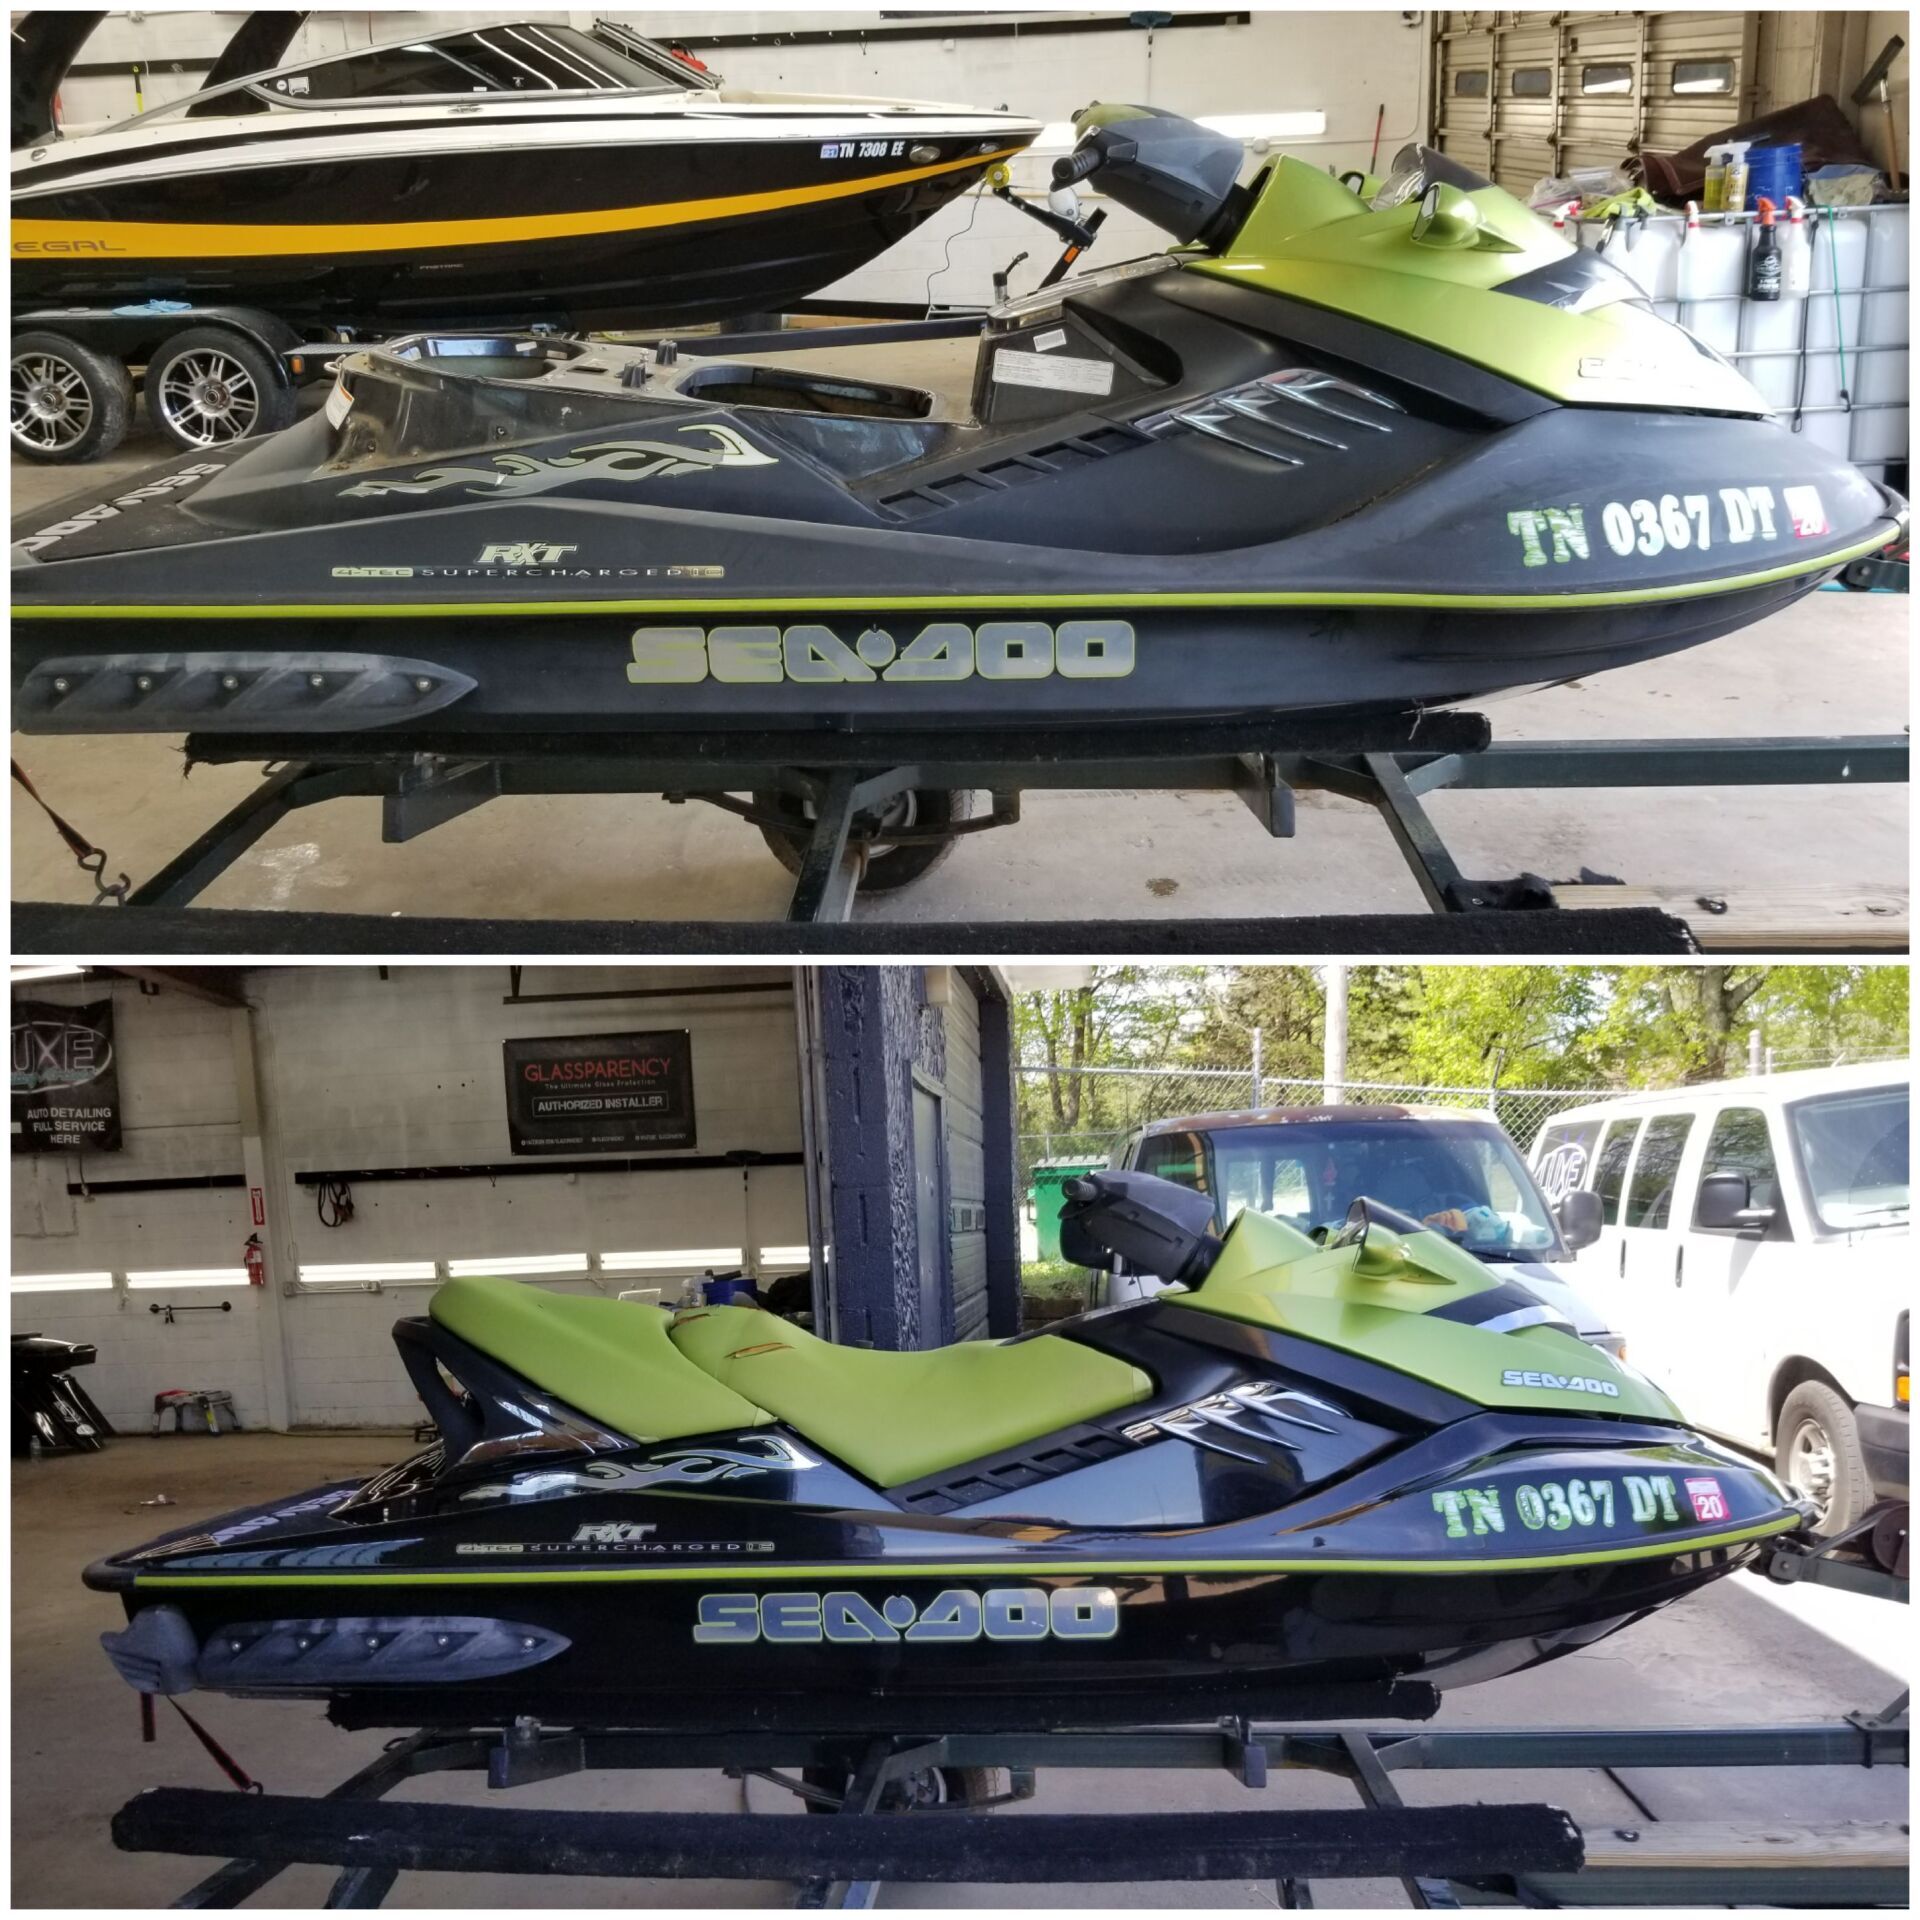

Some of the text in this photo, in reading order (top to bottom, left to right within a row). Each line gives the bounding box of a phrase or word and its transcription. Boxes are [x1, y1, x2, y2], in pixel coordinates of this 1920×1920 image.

[839, 142, 855, 158] TN
[859, 141, 888, 158] 7308
[891, 140, 906, 156] EE
[1506, 503, 1590, 567] TN
[1602, 494, 1710, 556] 0367
[1719, 486, 1777, 543] DT
[474, 541, 578, 566] RXT
[421, 568, 682, 578] SUPERCHARGED
[525, 1058, 671, 1082] GLASSPARENCY
[617, 1079, 656, 1087] Protection
[538, 1096, 663, 1112] AUTHORIZED INSTALLER
[27, 1107, 111, 1119] AUTO DETAILING
[33, 1121, 105, 1132] FULL SERVICE
[50, 1134, 80, 1144] HERE
[1432, 1475, 1724, 1538] TN 0367 DT 20
[572, 1521, 657, 1543] RXT
[530, 1543, 740, 1552] SUPERCHARGED
